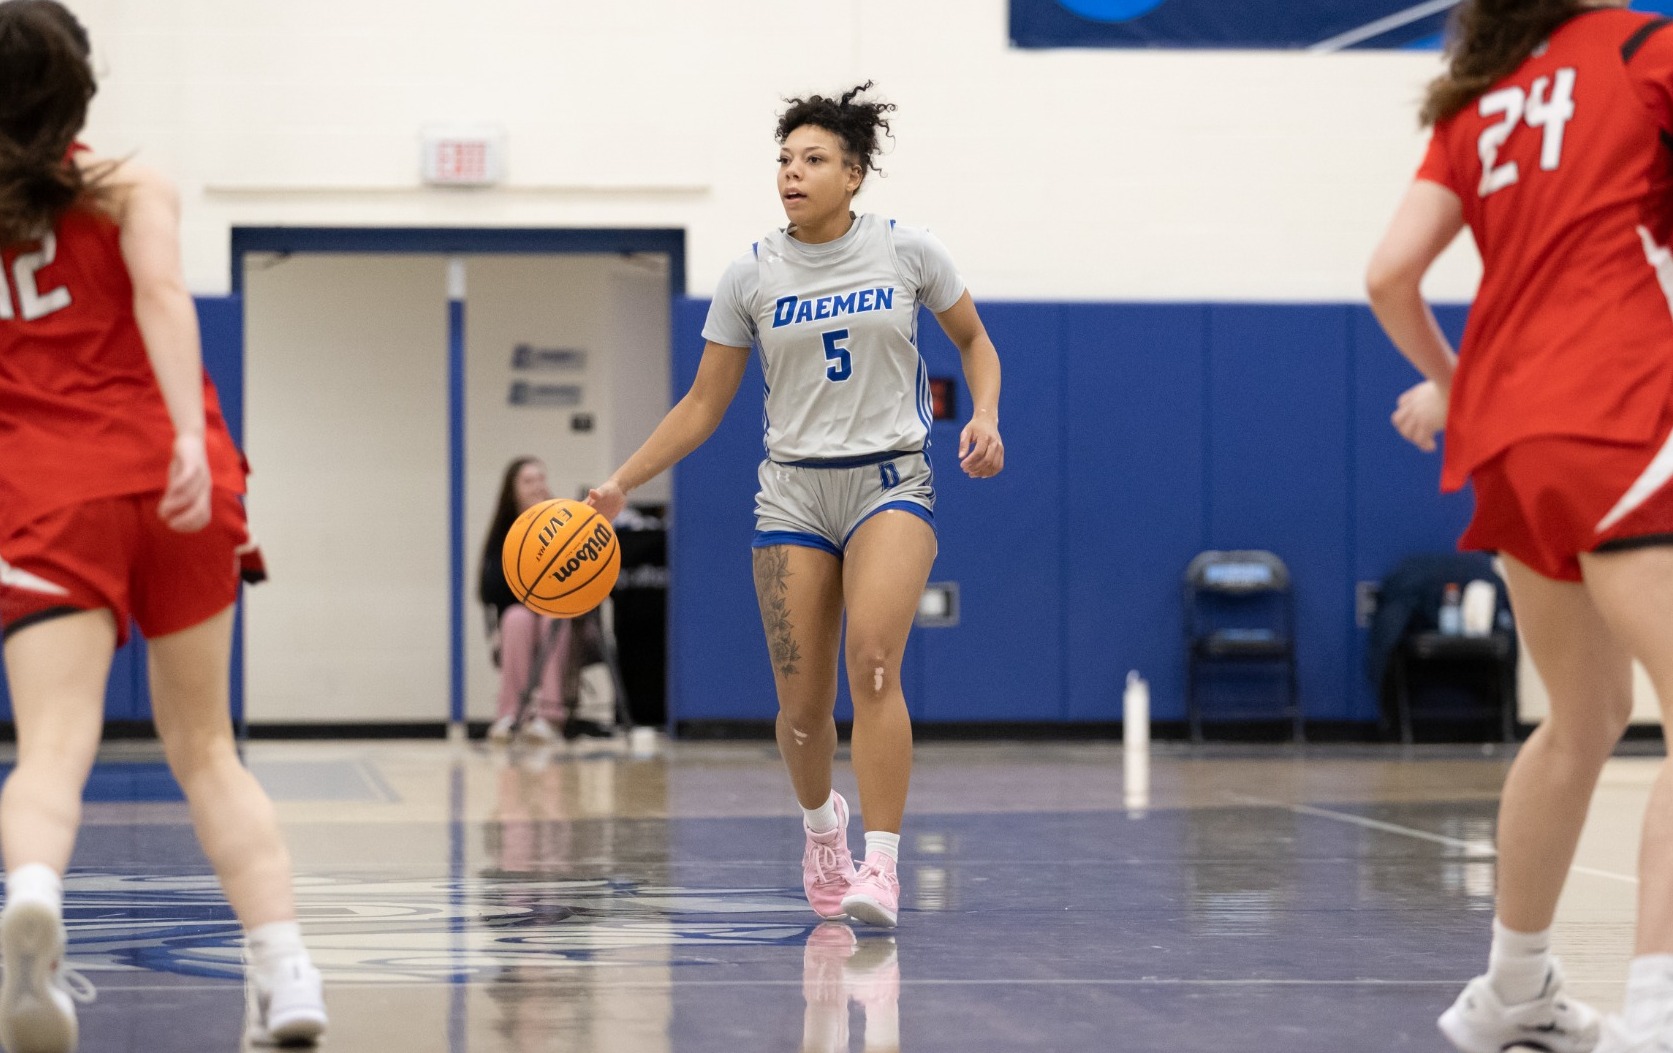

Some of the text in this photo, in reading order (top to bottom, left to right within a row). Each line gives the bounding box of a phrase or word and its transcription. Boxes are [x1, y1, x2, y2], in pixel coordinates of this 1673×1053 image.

[1478, 67, 1576, 197] 24
[821, 328, 853, 383] 5
[538, 507, 573, 547] EVO
[553, 523, 612, 582] Wilson
